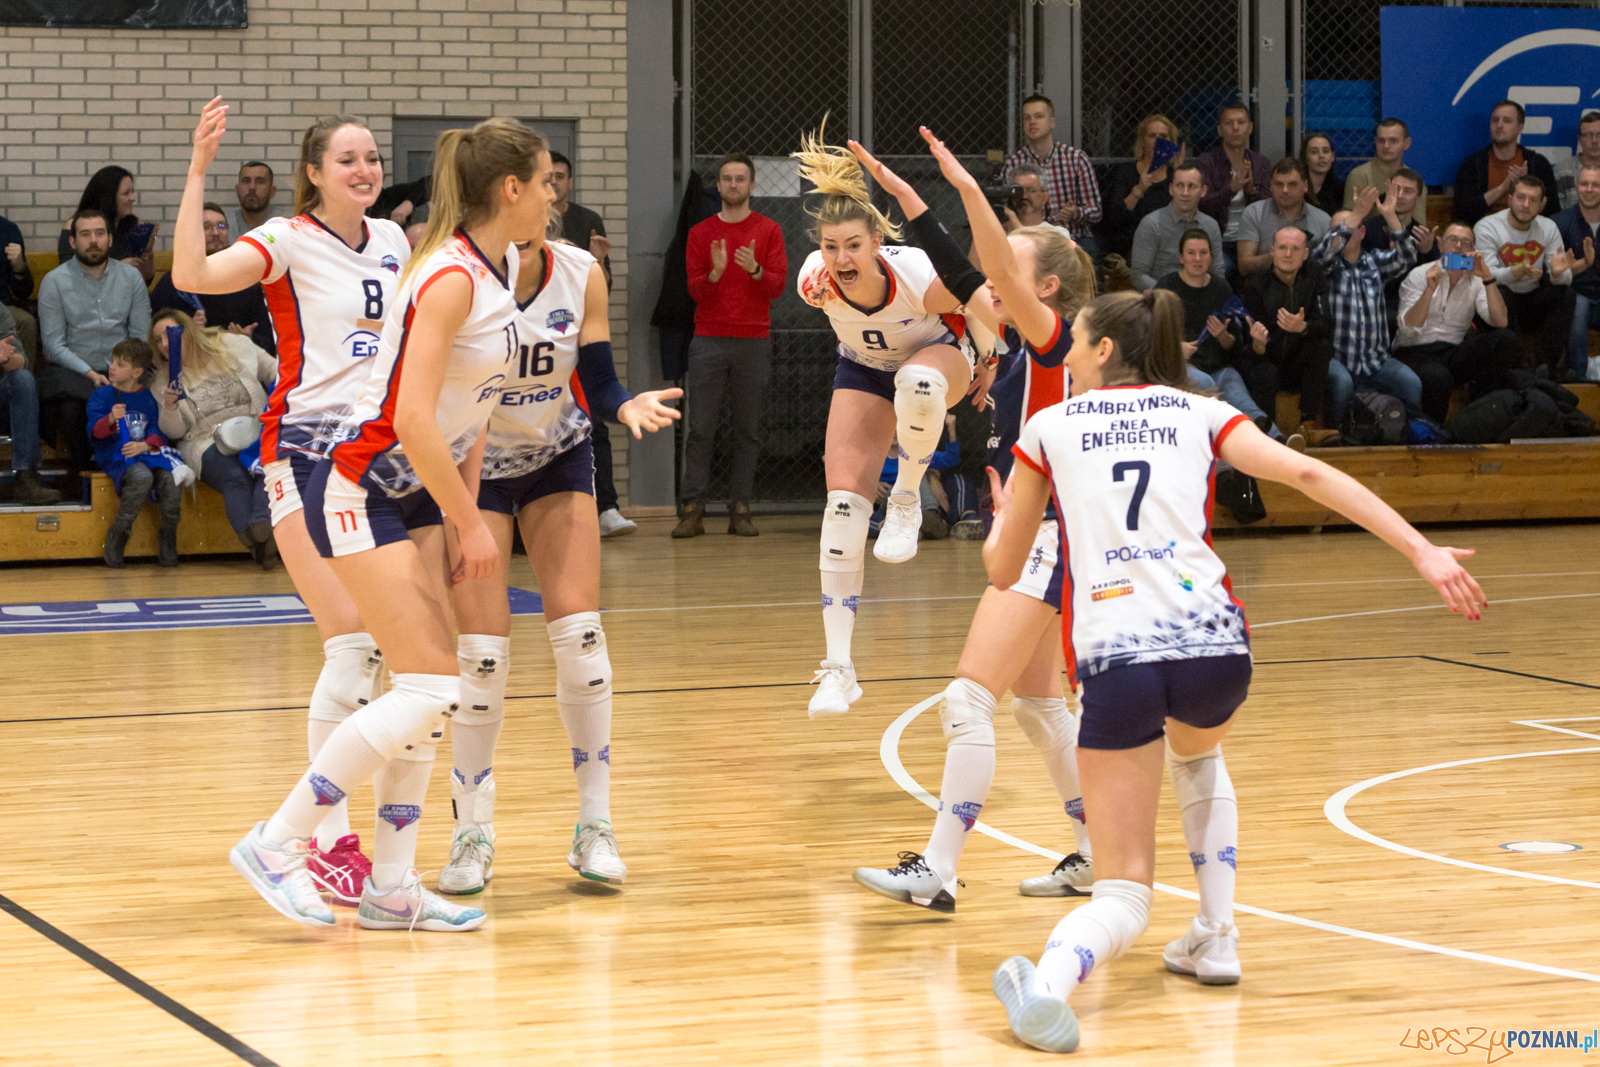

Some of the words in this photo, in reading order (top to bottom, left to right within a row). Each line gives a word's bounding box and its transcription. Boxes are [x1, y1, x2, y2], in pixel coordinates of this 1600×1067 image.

[362, 279, 383, 320] 8
[862, 329, 889, 350] 9
[519, 341, 555, 378] 16
[500, 386, 563, 406] Enea
[1066, 393, 1191, 416] CEMBRZYŃSKA
[1110, 419, 1149, 430] ENEA
[1082, 427, 1178, 452] ENERGETYK
[1112, 460, 1150, 531] 7
[335, 510, 358, 533] 11
